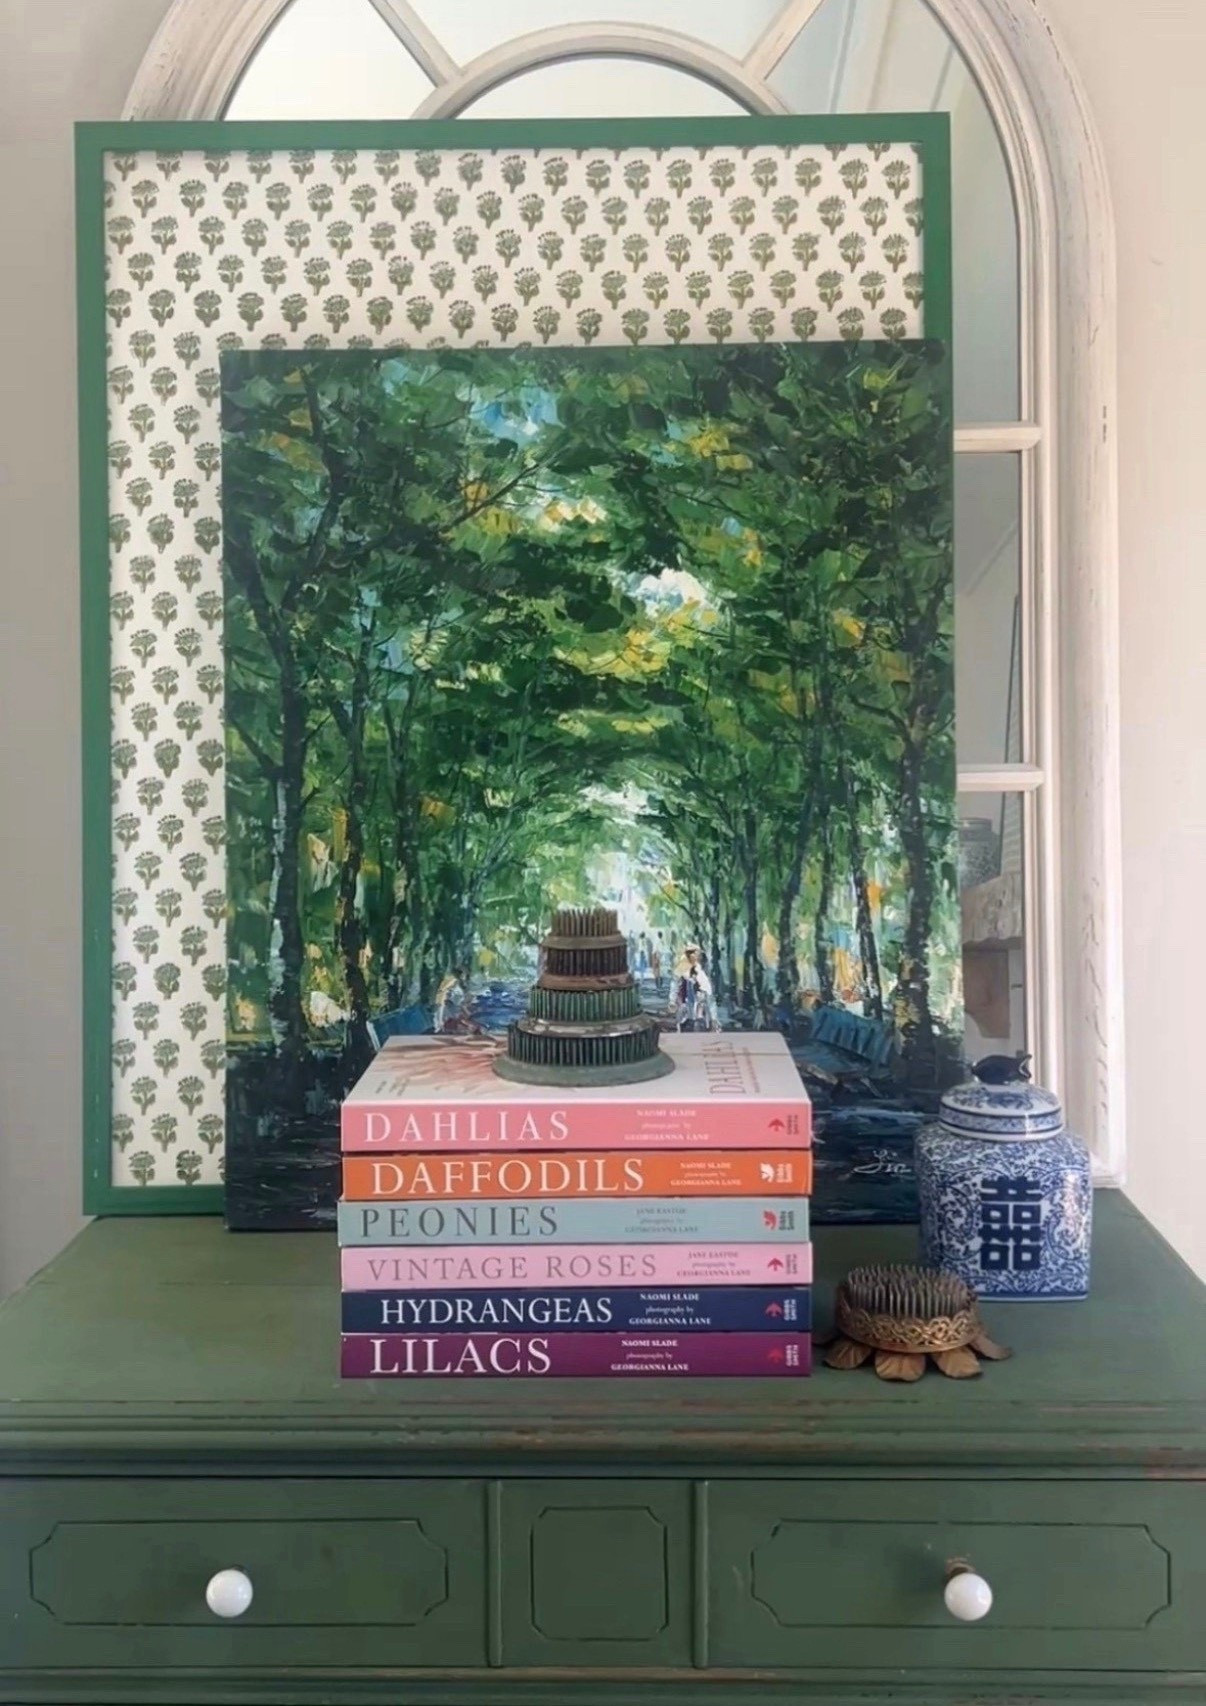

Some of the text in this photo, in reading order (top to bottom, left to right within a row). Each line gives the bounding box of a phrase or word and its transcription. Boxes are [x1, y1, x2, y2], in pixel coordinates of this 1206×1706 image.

[365, 1110, 569, 1143] DAHLIAS
[371, 1158, 644, 1195] DAFFODILS
[361, 1206, 558, 1238] PEONIES
[367, 1254, 657, 1281] VINTAGE ROSES
[640, 1293, 700, 1301] NAOMI SLADE
[381, 1297, 613, 1325] HYDRANGEAS
[645, 1305, 694, 1314] photography by
[629, 1317, 712, 1325] GEORGIANNA LANE
[621, 1339, 678, 1347] NAOMI SLADE
[370, 1338, 551, 1375] LILACS
[665, 1351, 673, 1360] by
[611, 1363, 689, 1371] GEORGIANNA LANE
